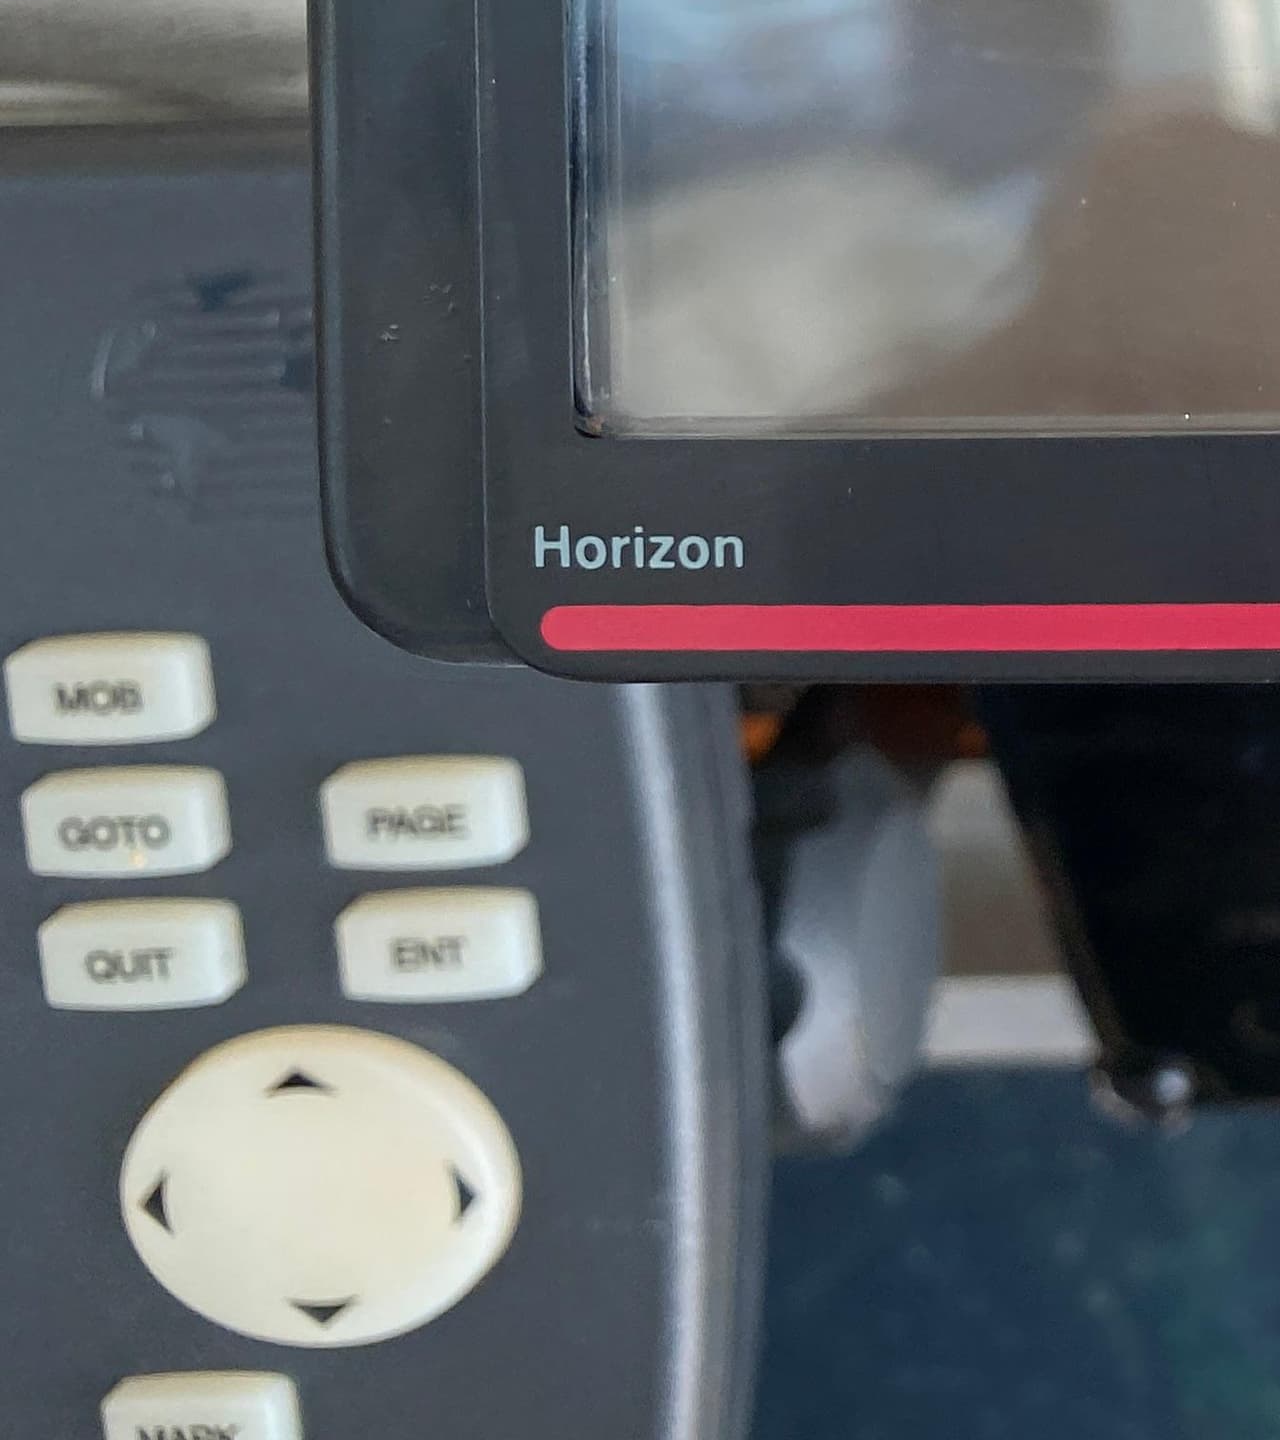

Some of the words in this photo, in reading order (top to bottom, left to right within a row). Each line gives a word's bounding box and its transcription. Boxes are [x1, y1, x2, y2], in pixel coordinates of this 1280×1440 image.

[534, 525, 744, 570] Horizon
[55, 681, 143, 715] MOB
[58, 815, 171, 852] GOTO
[366, 804, 469, 839] PAGE
[84, 947, 174, 984] QUIT
[389, 936, 466, 973] ENT
